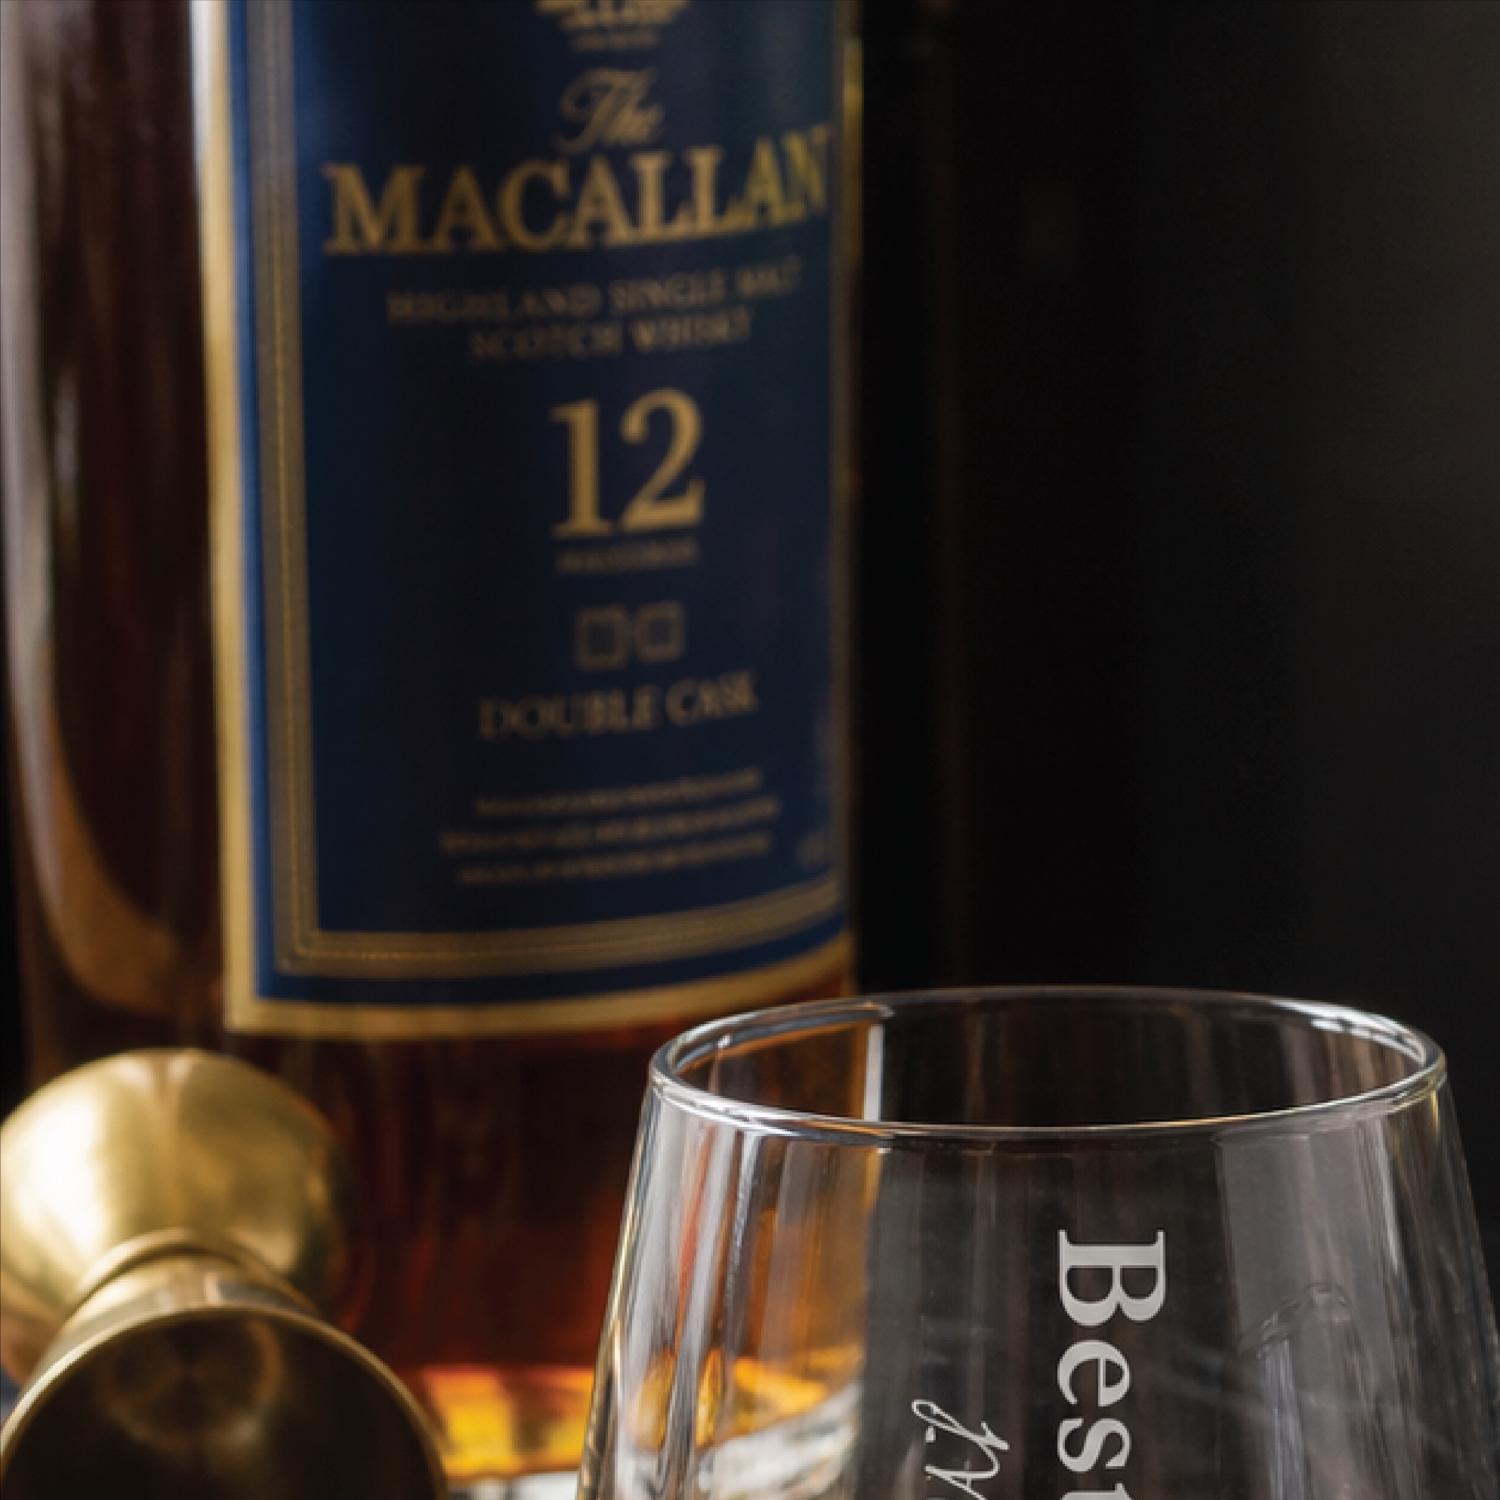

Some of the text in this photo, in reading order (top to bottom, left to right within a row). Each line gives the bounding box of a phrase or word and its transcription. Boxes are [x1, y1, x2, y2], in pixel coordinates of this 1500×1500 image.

[556, 67, 664, 154] The
[324, 124, 834, 255] MACALLAN
[551, 388, 705, 537] 12
[479, 687, 656, 738] DOUBLE
